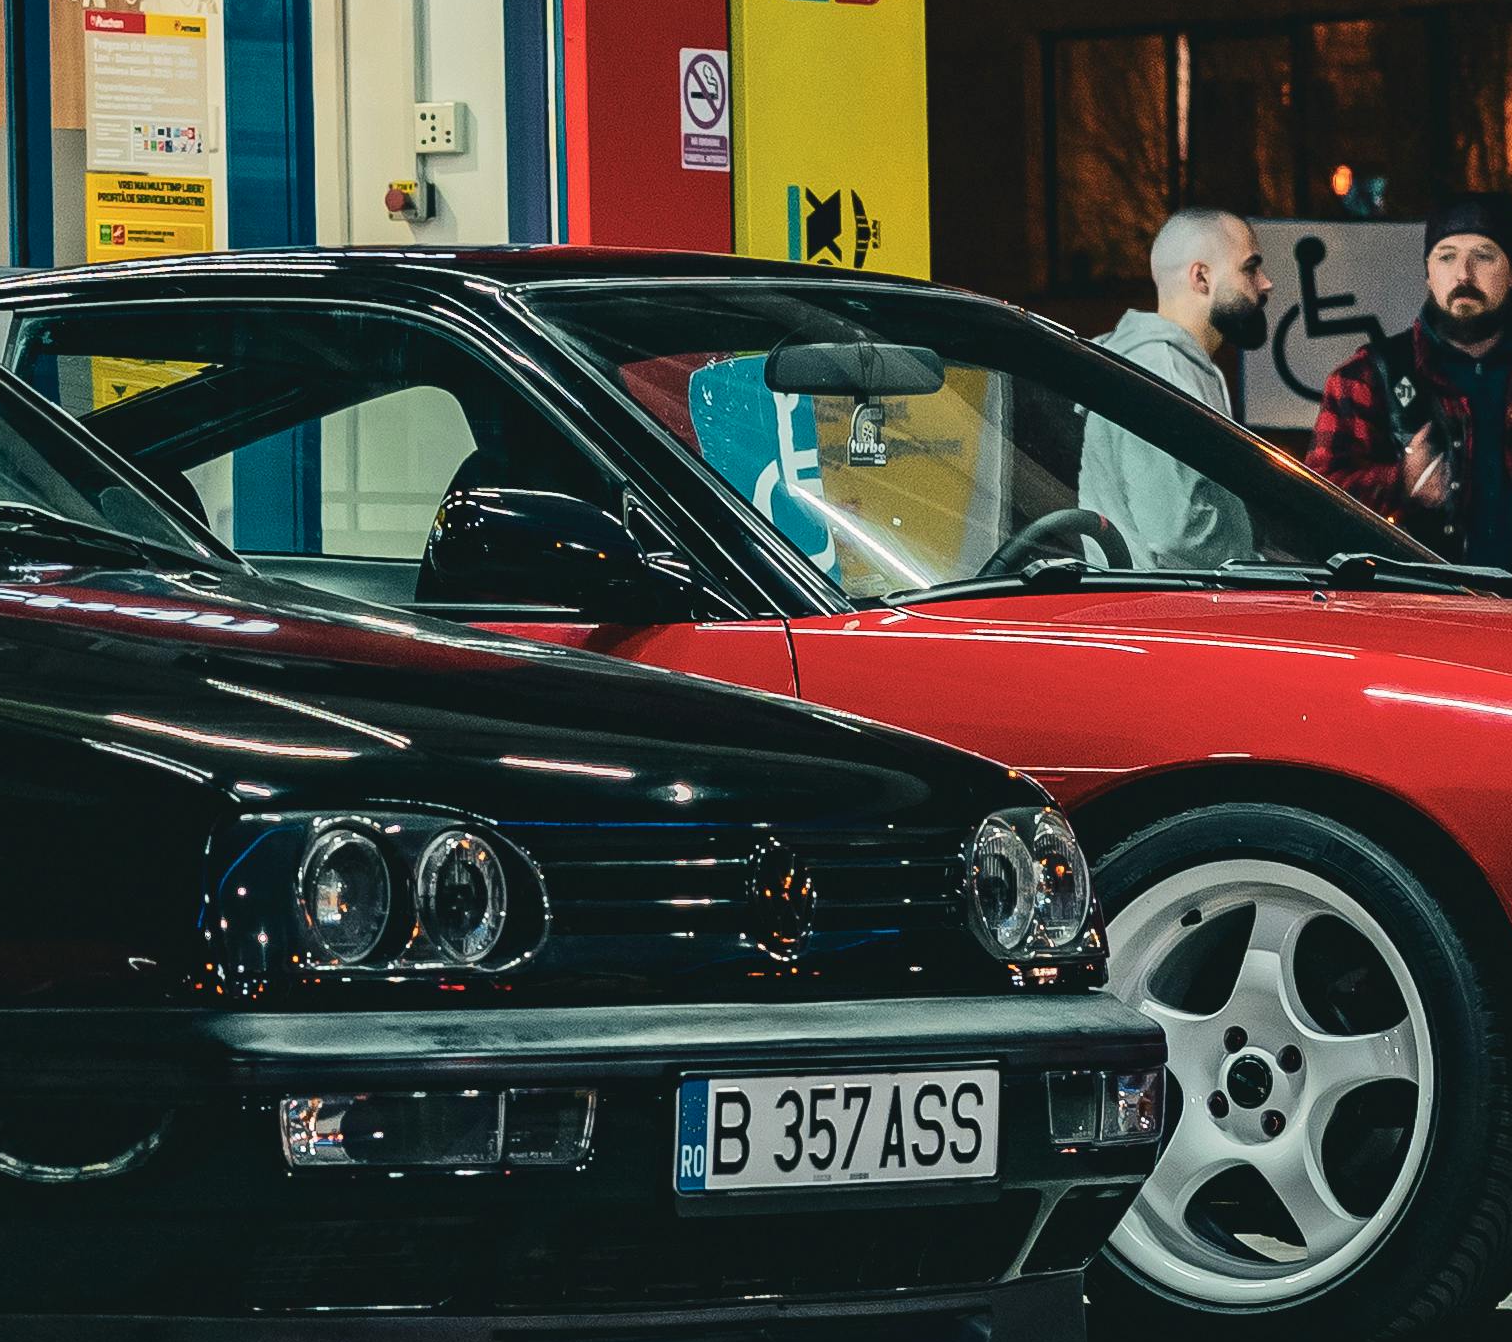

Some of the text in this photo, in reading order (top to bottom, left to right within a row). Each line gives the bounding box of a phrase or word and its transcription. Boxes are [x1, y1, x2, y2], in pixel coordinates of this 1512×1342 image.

[850, 436, 886, 454] turbo
[712, 1081, 984, 1176] B 357 ASS
[680, 1144, 705, 1178] RO
